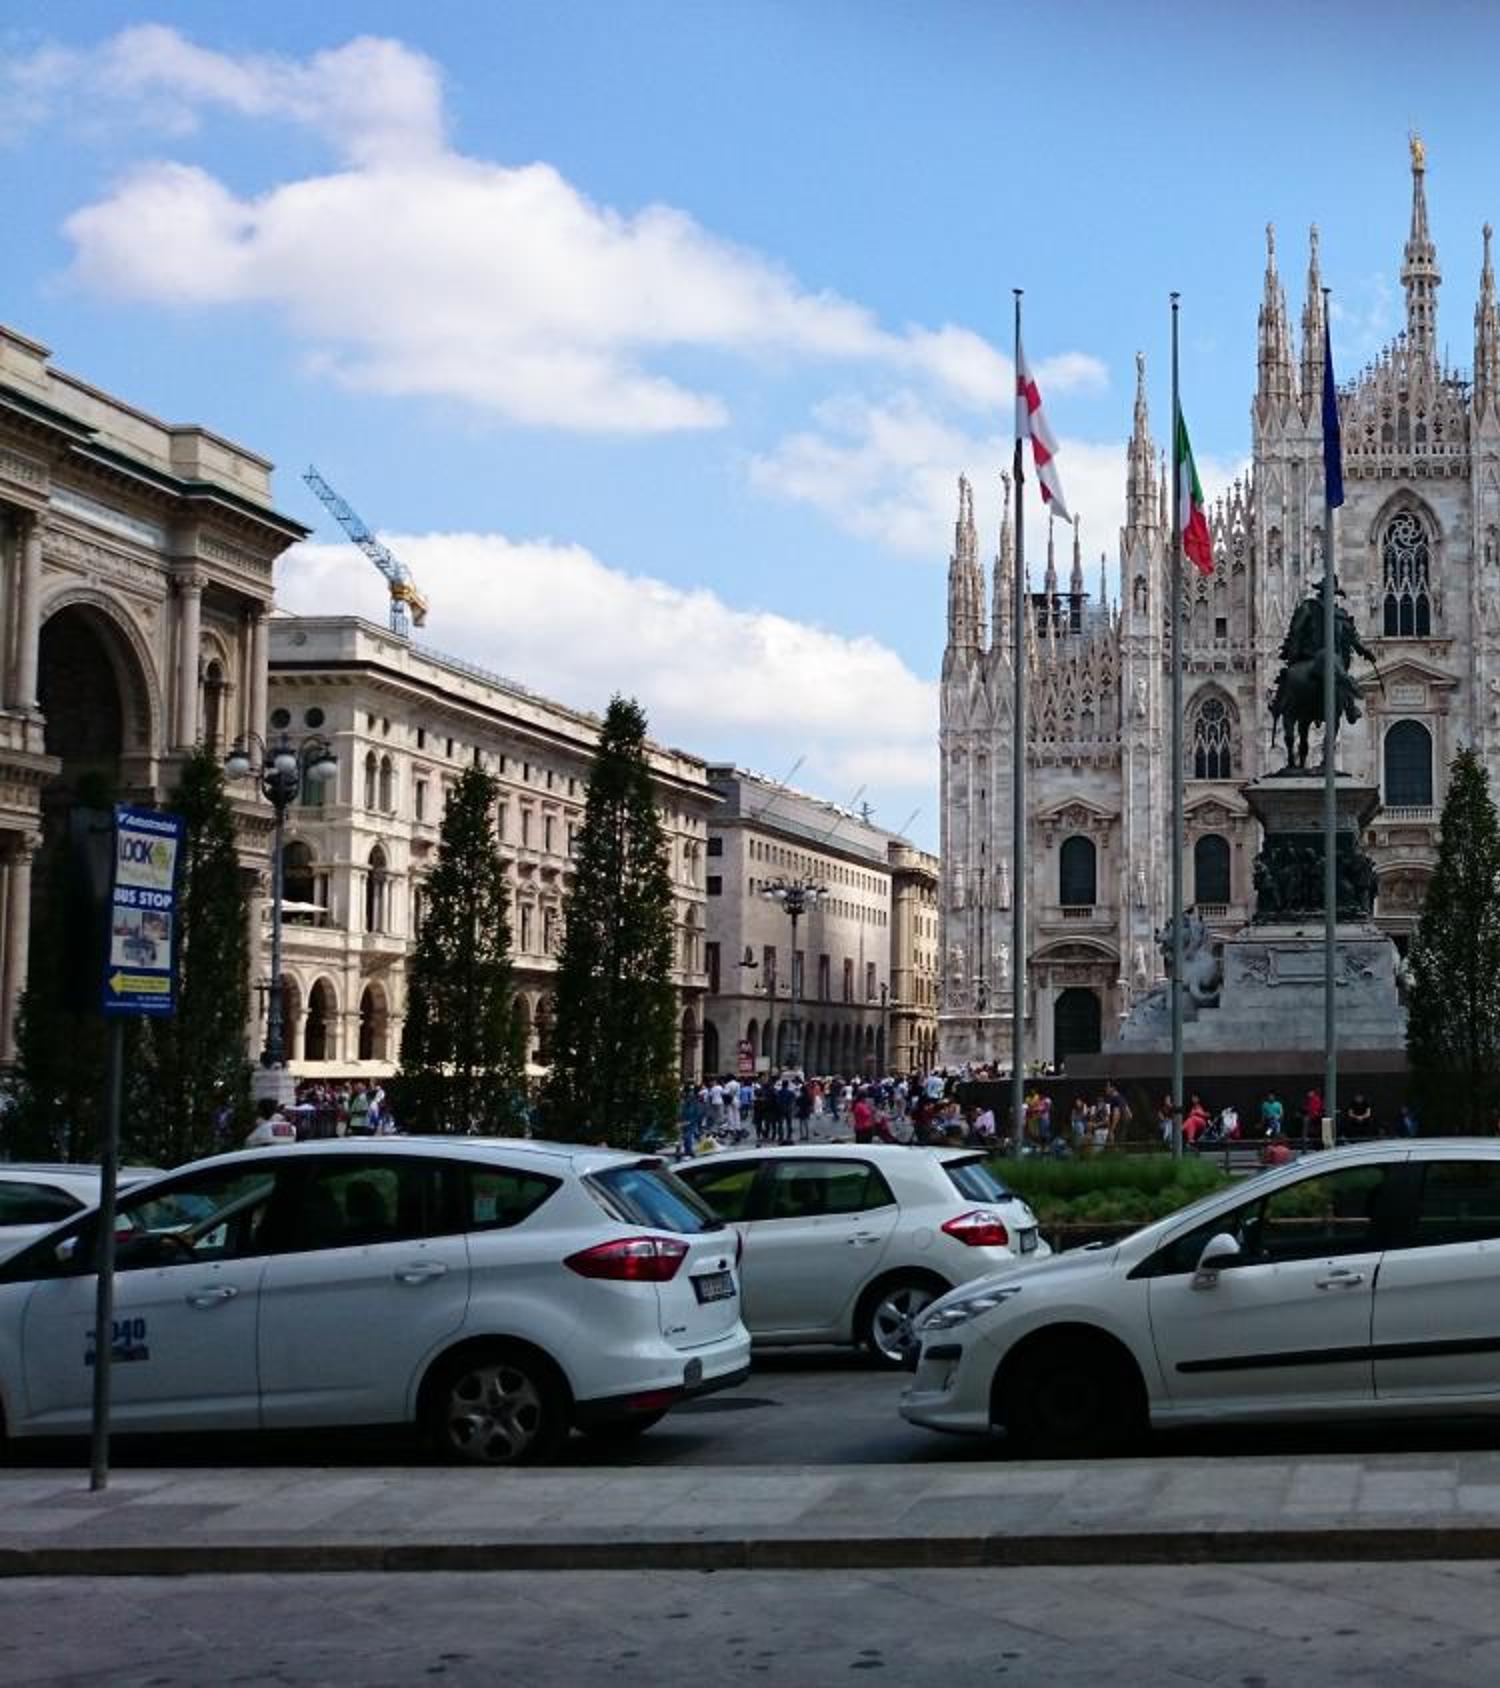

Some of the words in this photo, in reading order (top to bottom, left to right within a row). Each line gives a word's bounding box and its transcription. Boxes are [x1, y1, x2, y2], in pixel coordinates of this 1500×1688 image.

[119, 837, 153, 865] LOOK
[113, 887, 136, 904] BUS
[139, 891, 172, 907] STOP
